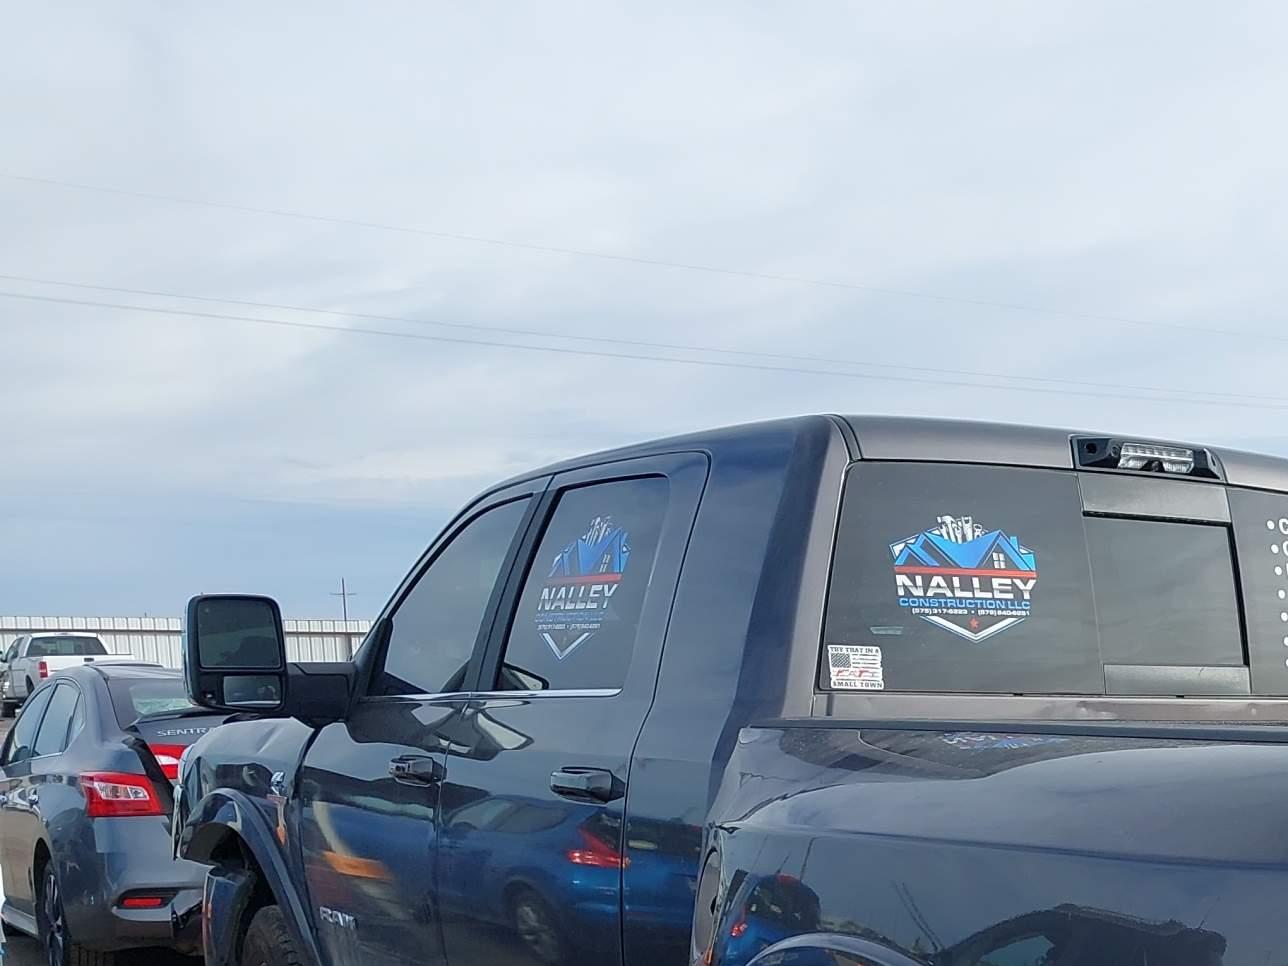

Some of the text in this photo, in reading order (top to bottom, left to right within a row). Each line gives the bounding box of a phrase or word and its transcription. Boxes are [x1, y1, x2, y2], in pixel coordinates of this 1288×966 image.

[537, 583, 619, 611] NALLEY
[895, 574, 1037, 600] NALLEY
[899, 597, 1006, 609] CONSTRUCTION
